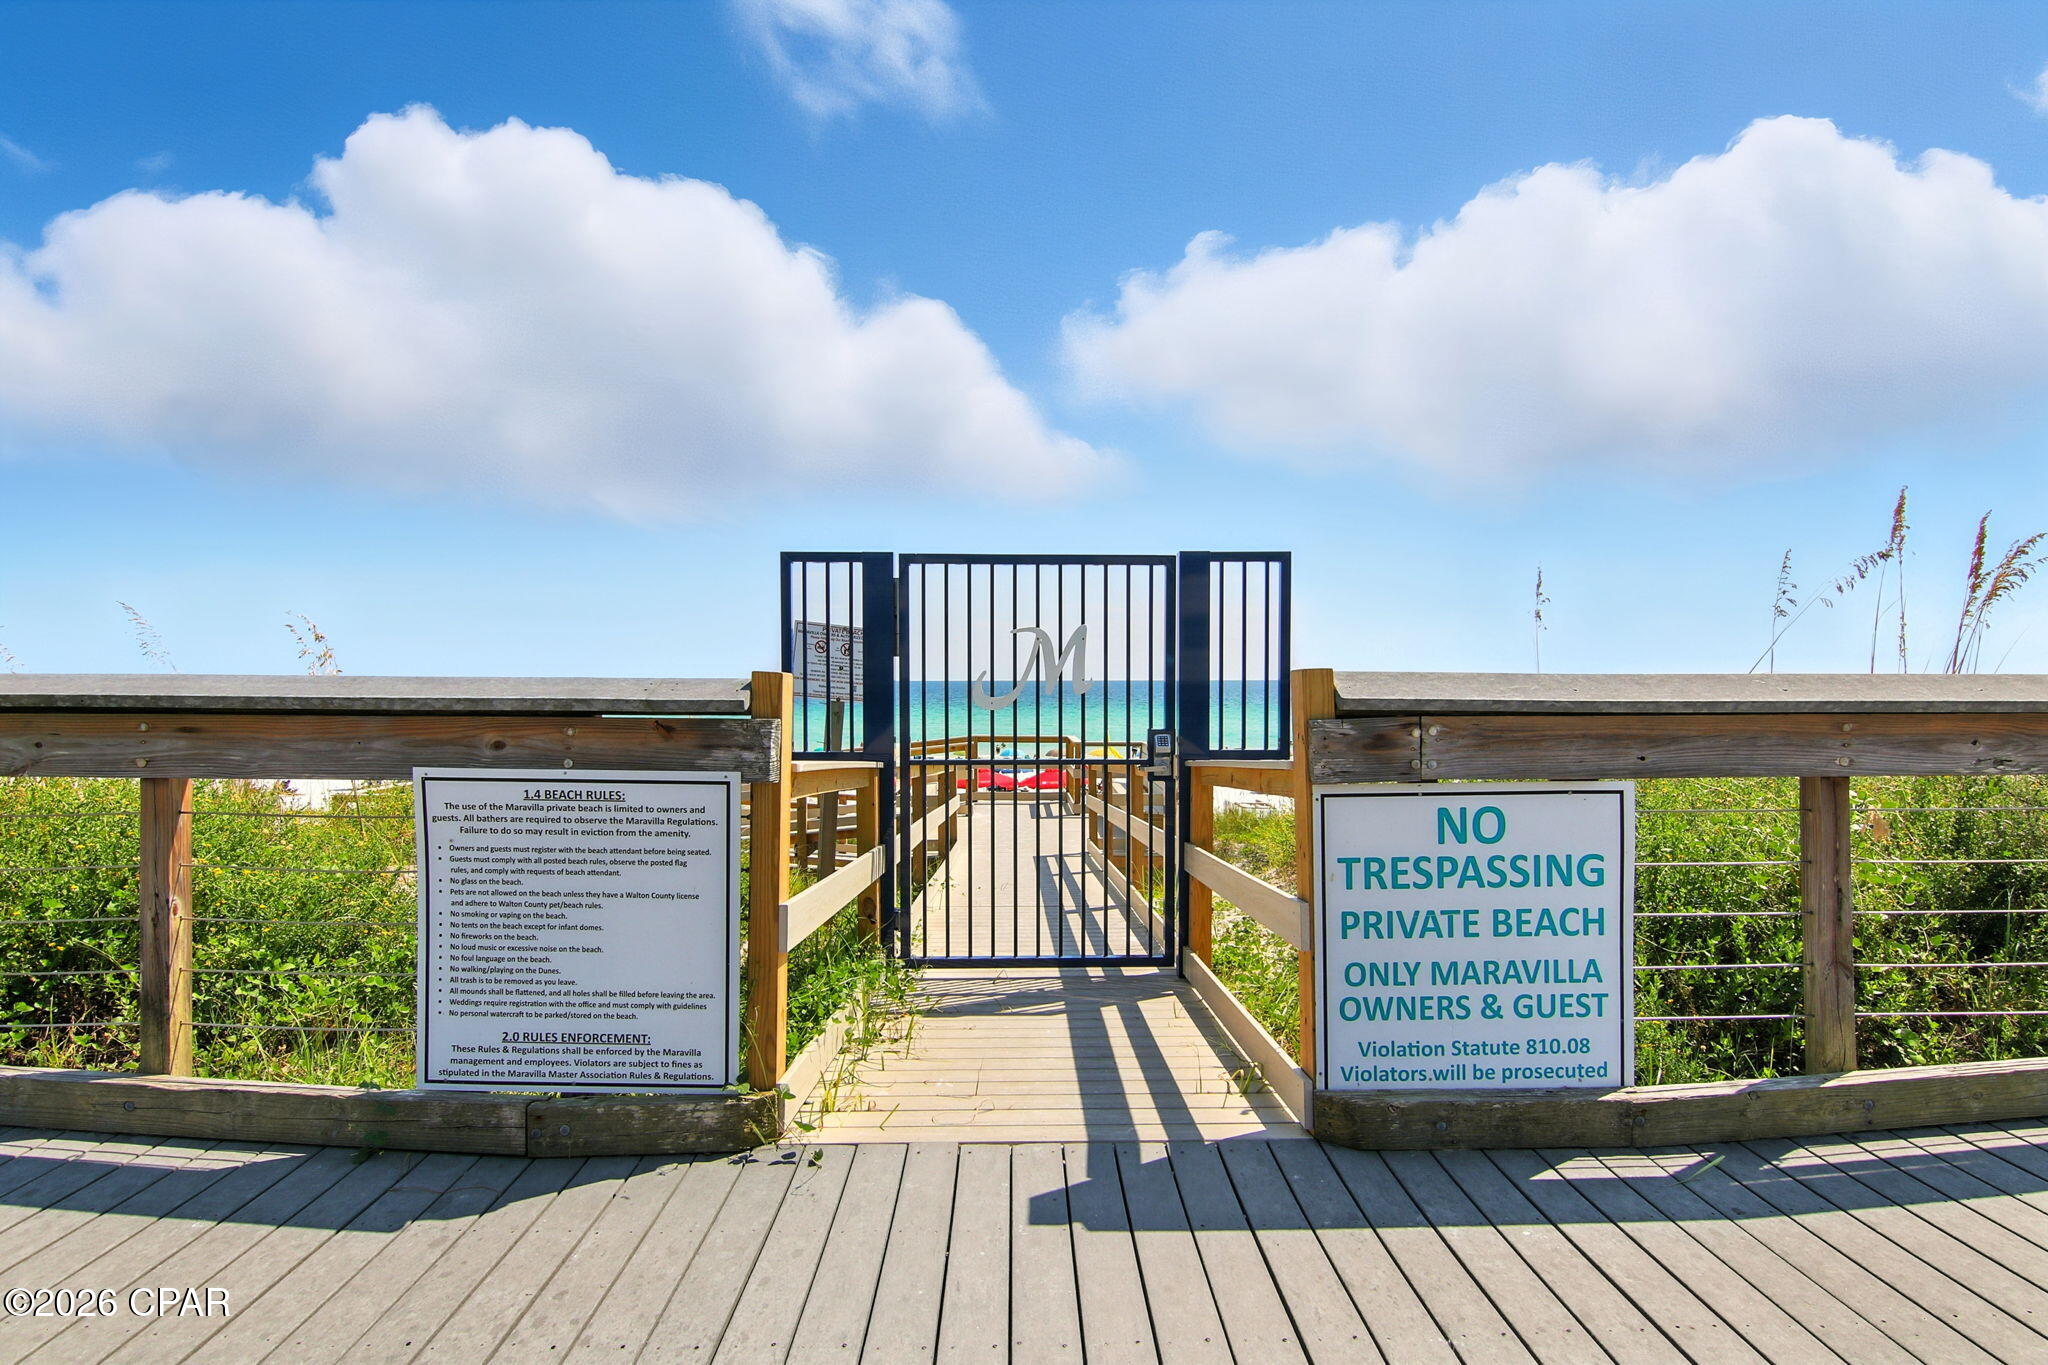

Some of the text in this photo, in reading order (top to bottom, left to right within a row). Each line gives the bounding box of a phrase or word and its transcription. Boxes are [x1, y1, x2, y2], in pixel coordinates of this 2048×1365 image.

[524, 789, 626, 800] 1.4 BEACH RULES:
[505, 803, 544, 812] Maravilla
[546, 804, 575, 813] private
[578, 804, 603, 812] beach
[613, 805, 643, 813] limited
[689, 806, 705, 814] and
[431, 814, 461, 824] guests.
[476, 815, 508, 823] bathers
[525, 816, 561, 825] required
[574, 816, 607, 824] observe
[625, 817, 664, 825] Maravilla
[666, 817, 718, 828] Regulations.
[1437, 806, 1506, 845] NO
[459, 826, 487, 834] Failure
[500, 827, 511, 835] do
[544, 828, 568, 836] result
[580, 828, 614, 836] eviction
[615, 828, 636, 837] from
[654, 829, 690, 839] amenity.
[531, 846, 556, 855] register
[666, 848, 686, 856] being
[1337, 854, 1605, 890] TRESPASSING
[460, 877, 477, 886] glass
[461, 910, 489, 920] smoking
[498, 912, 521, 920] vaping
[1341, 907, 1604, 939] PRIVATE BEACH
[460, 965, 513, 975] walking/playing
[1344, 958, 1603, 987] ONLY MARAVILLA
[514, 989, 547, 997] flattened,
[660, 992, 684, 1000] leaving
[1339, 992, 1608, 1021] OWNERS & GUEST
[460, 1010, 488, 1018] personal
[544, 1011, 591, 1020] parked/stored
[502, 1031, 652, 1043] 2.0 RULES ENFORCEMENT:
[451, 1045, 475, 1053] These
[478, 1045, 500, 1053] Rules
[511, 1046, 559, 1056] Regulations
[561, 1047, 580, 1055] shall
[595, 1047, 632, 1056] enforced
[634, 1048, 644, 1057] by
[662, 1048, 701, 1057] Maravilla
[1358, 1038, 1590, 1057] Violation Statute 810.08
[450, 1058, 504, 1067] management
[506, 1058, 522, 1066] and
[524, 1058, 571, 1068] employees.
[573, 1059, 611, 1067] Violators
[628, 1060, 658, 1069] subject
[671, 1060, 691, 1068] fines
[438, 1068, 479, 1078] stipulated
[507, 1070, 546, 1078] Maravilla
[579, 1071, 627, 1079] Association
[663, 1072, 714, 1082] Regulations.
[1433, 1063, 1466, 1081] will
[1473, 1063, 1496, 1080] be
[1502, 1061, 1608, 1083] prosecuted
